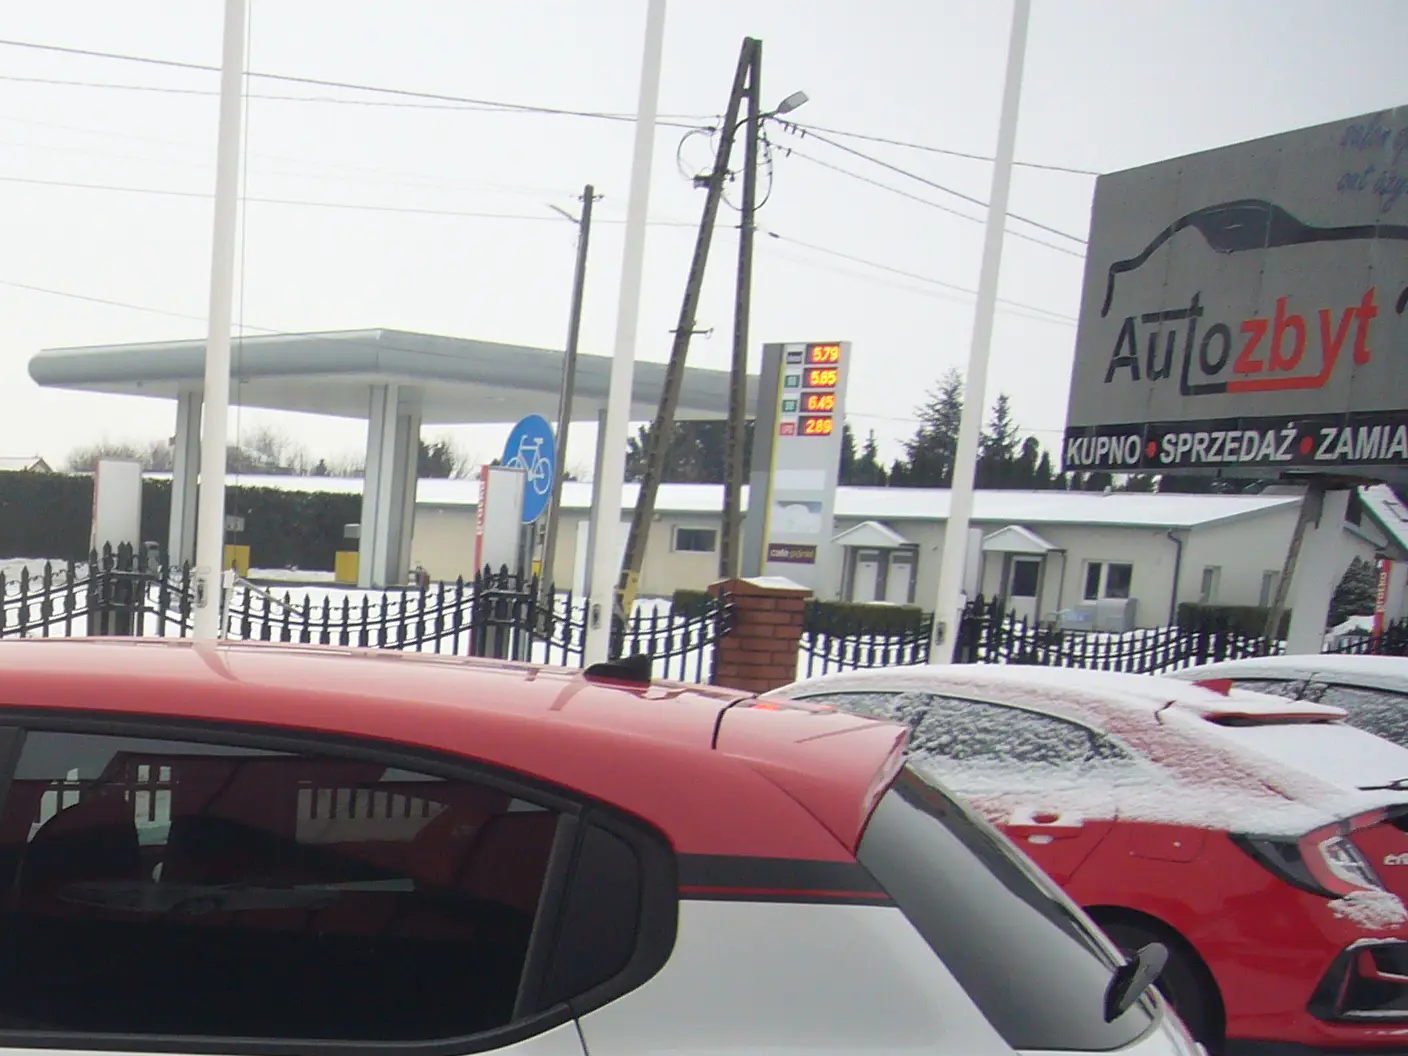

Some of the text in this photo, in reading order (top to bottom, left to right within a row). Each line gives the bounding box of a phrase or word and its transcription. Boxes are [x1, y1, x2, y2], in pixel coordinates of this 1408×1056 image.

[1066, 423, 1408, 465] KUPNO SPRZEDAŻ ZAMIA
